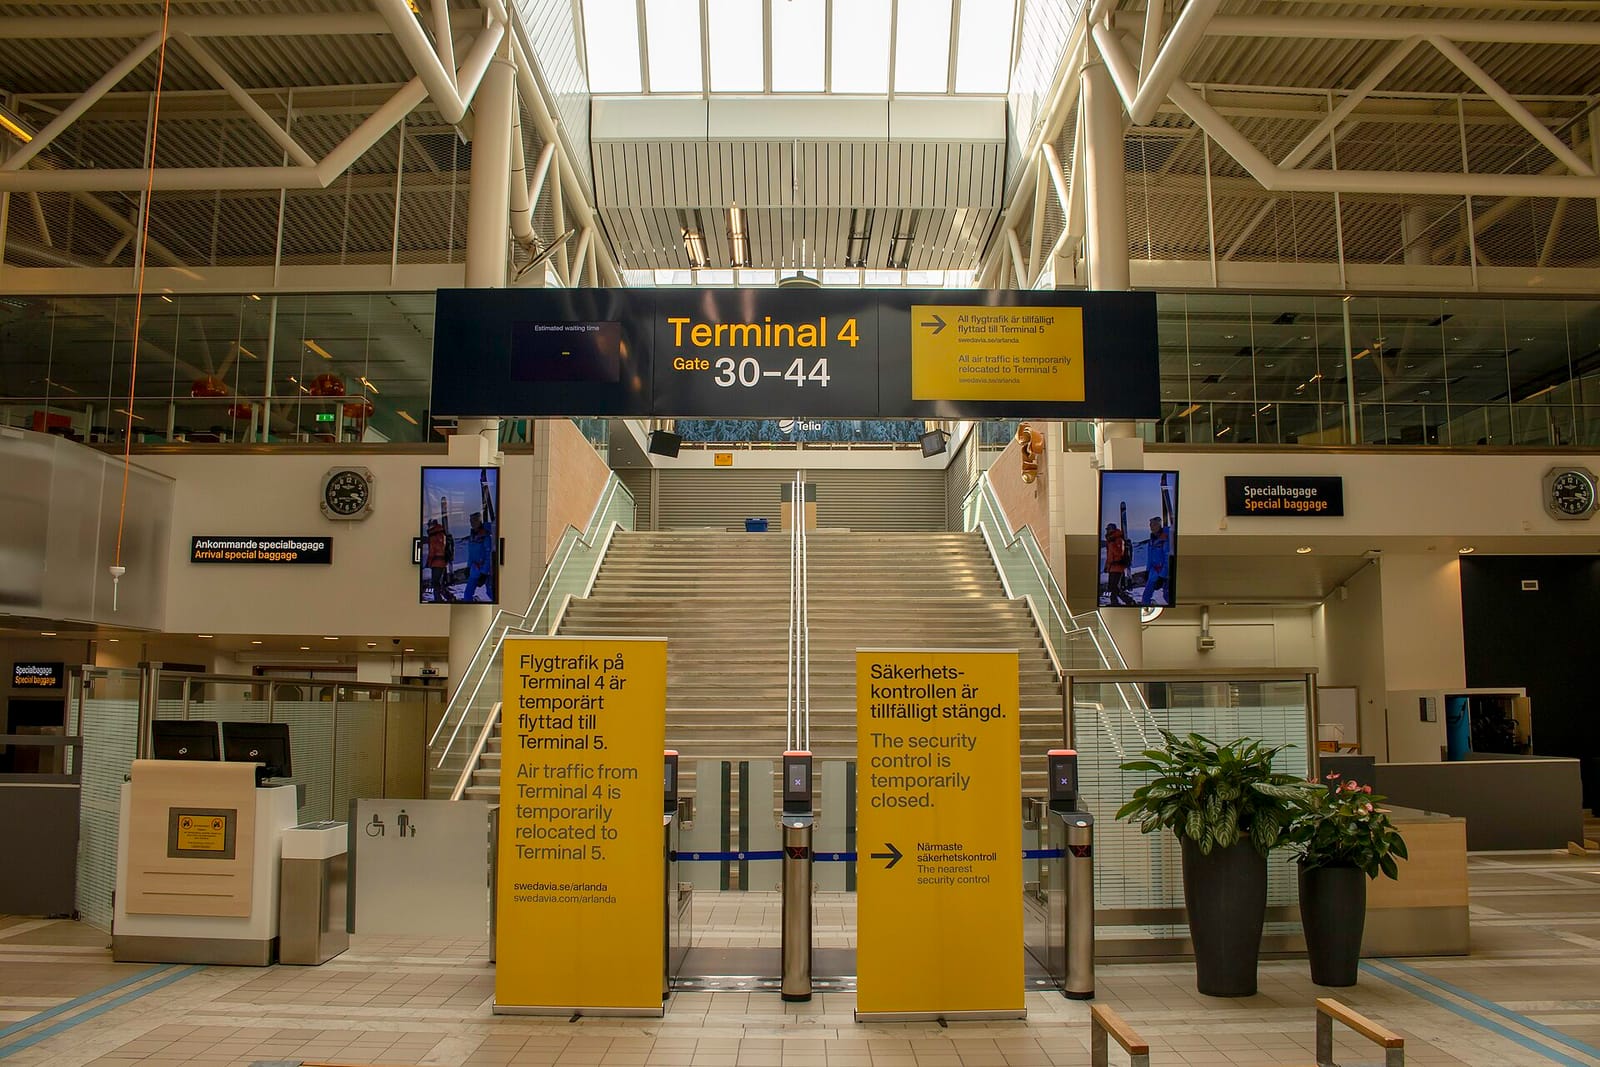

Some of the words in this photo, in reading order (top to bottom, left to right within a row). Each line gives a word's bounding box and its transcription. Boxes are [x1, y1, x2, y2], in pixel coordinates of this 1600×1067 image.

[957, 314, 969, 324] All
[971, 314, 1009, 326] flygtrafik
[1011, 315, 1020, 324] är
[1022, 314, 1055, 326] tillfälligt
[565, 325, 586, 333] waiting
[667, 316, 827, 348] Terminal
[837, 318, 860, 348] 4
[958, 324, 986, 335] flyttad
[988, 325, 998, 333] till
[1000, 325, 1037, 334] Terminal
[1039, 326, 1045, 334] 5
[673, 357, 710, 370] Gate
[958, 355, 969, 363] All
[971, 355, 982, 363] air
[985, 355, 1010, 364] traffic
[1013, 356, 1020, 364] is
[1022, 355, 1072, 366] temporarily
[958, 365, 1000, 374] relocated
[1002, 366, 1011, 374] to
[1013, 365, 1050, 374] Terminal
[1052, 366, 1058, 374] 5
[796, 420, 822, 431] Telia
[1244, 485, 1318, 499] Specialbagage
[1244, 498, 1281, 511] Special
[1284, 498, 1328, 511] baggage
[195, 539, 258, 550] Ankommande
[259, 539, 325, 552] specialbagage
[195, 549, 223, 559] Arrival
[225, 550, 257, 560] special
[258, 550, 298, 561] baggage
[519, 654, 599, 673] Flygtrafik
[603, 652, 625, 674] på
[15, 665, 52, 676] Specialbagage
[870, 663, 965, 680] Säkerhets-
[15, 675, 34, 685] Special
[34, 675, 56, 686] baggage
[519, 674, 590, 690] Terminal
[594, 675, 605, 690] 4
[609, 674, 627, 690] är
[870, 683, 957, 700] kontrollen
[961, 683, 979, 700] är
[518, 695, 605, 713] temporärt
[870, 703, 938, 723] tillfälligt
[942, 703, 1006, 723] stängd.
[518, 713, 573, 733] flyttad
[578, 714, 597, 730] till
[517, 734, 588, 750] Terminal
[592, 735, 608, 750] 5.
[870, 732, 904, 749] The
[908, 732, 977, 752] security
[870, 752, 934, 769] control
[937, 752, 952, 769] is
[516, 763, 540, 779] Air
[543, 763, 594, 780] traffic
[598, 763, 639, 780] from
[870, 772, 971, 791] temporarily
[516, 784, 588, 800] Terminal
[592, 784, 603, 800] 4
[607, 784, 622, 800] is
[870, 792, 935, 809] closed.
[515, 804, 613, 823] temporarily
[515, 824, 597, 840] relocated
[600, 824, 618, 840] to
[515, 844, 587, 860] Terminal
[590, 845, 606, 861] 5.
[917, 842, 963, 852] Närmaste
[917, 852, 997, 863] säkerhetskontroll
[917, 864, 935, 874] The
[938, 864, 973, 874] nearest
[513, 881, 608, 893] swedavia.se/arlanda
[916, 875, 955, 886] security
[957, 875, 990, 885] control
[513, 894, 617, 905] swedavia.com/arlanda
